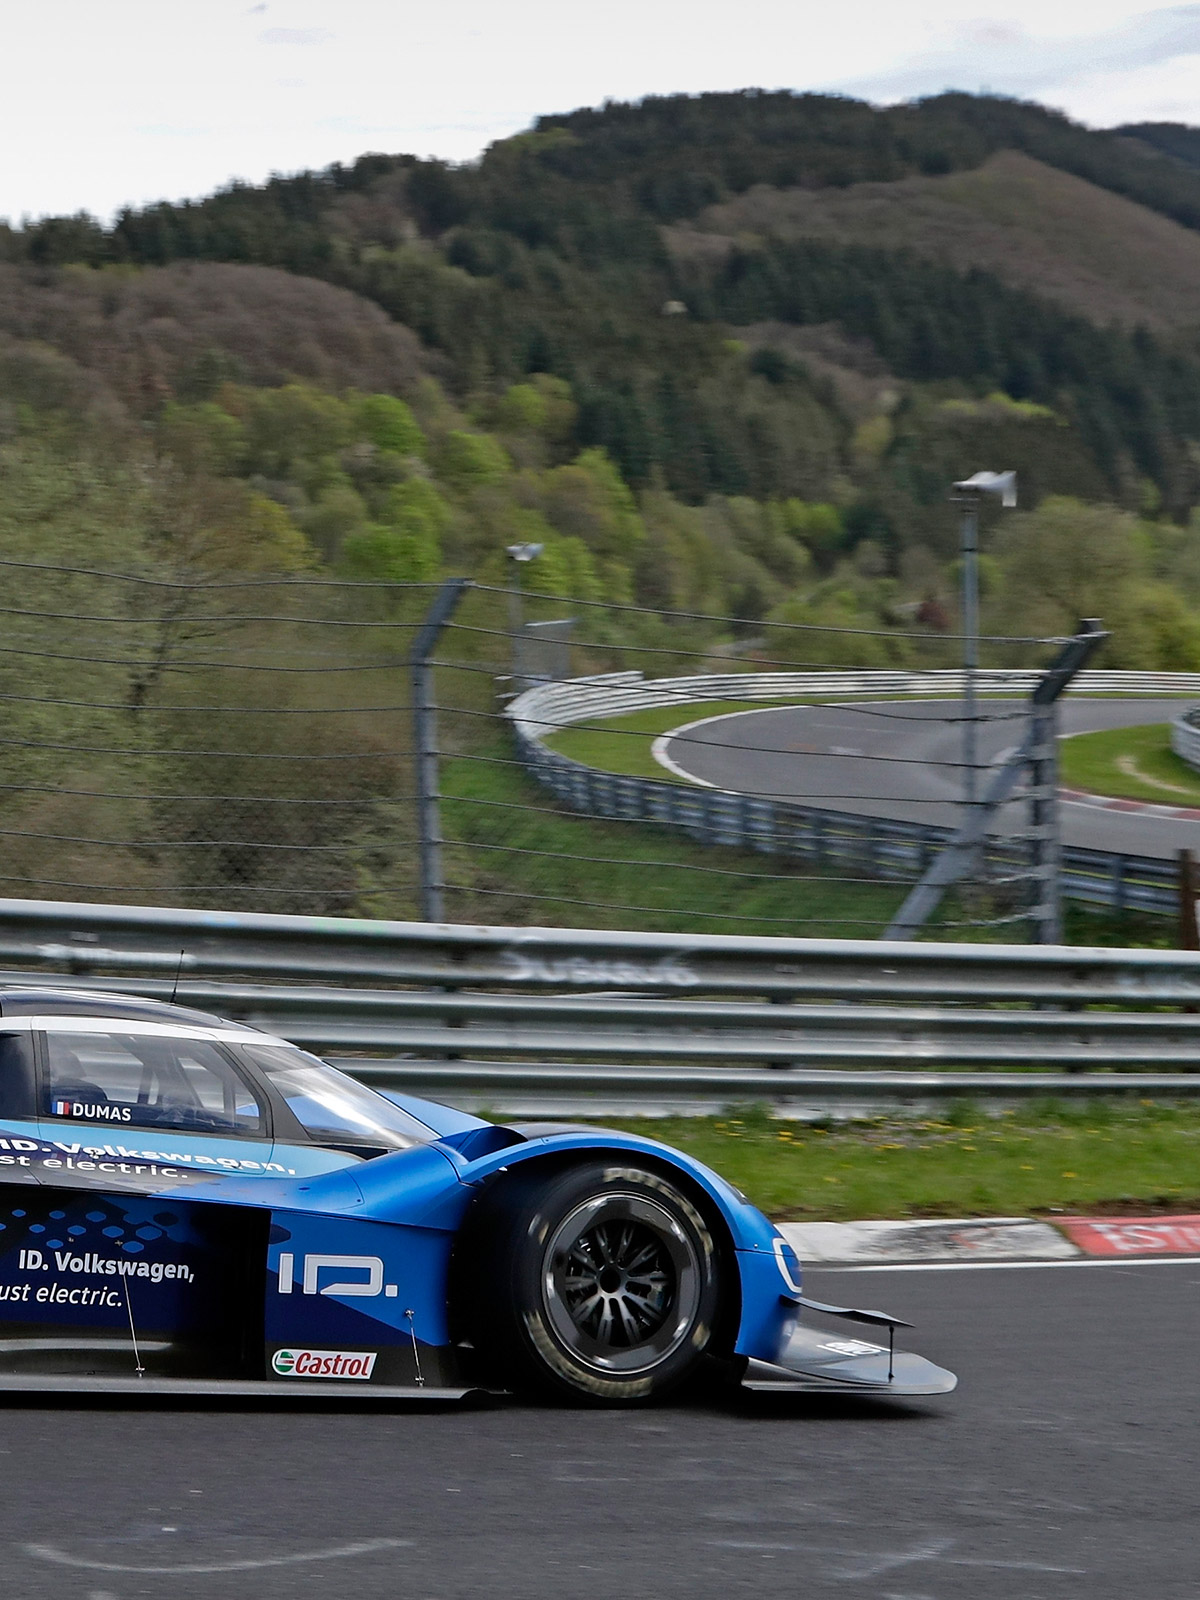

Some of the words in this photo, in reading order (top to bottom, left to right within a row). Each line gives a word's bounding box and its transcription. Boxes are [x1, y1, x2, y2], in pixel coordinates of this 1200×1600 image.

[72, 1103, 131, 1121] DUMAS
[43, 1158, 188, 1178] electric.
[53, 1142, 296, 1175] Volkswagen,
[19, 1250, 49, 1270] ID.
[55, 1252, 194, 1283] Volkswagen,
[36, 1283, 122, 1307] electric.
[295, 1352, 370, 1376] Castrol
